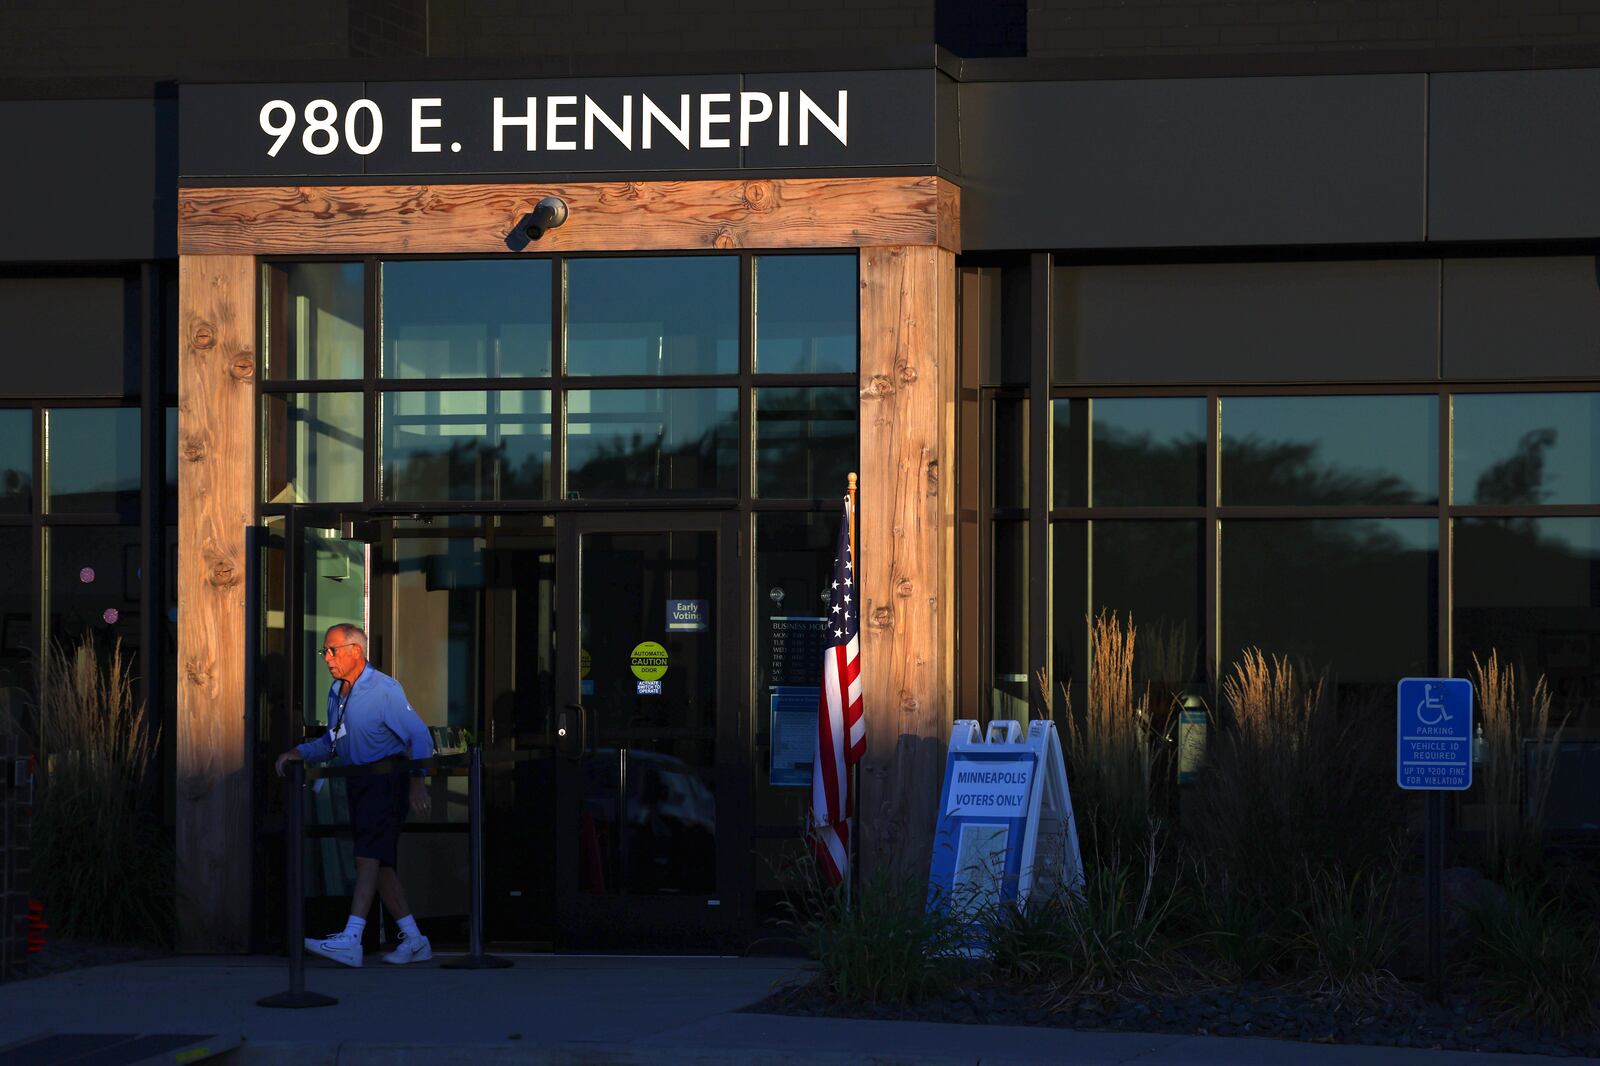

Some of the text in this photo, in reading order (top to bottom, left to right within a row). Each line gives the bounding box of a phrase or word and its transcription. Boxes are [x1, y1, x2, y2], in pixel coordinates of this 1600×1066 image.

[259, 89, 848, 158] 980 E. HENNEPIN
[677, 603, 698, 613] Early
[772, 622, 806, 630] BUSINESS
[631, 658, 668, 666] CAUTION
[1416, 727, 1454, 735] PARKING
[1411, 742, 1446, 750] VEHICLE
[1413, 751, 1456, 760] REQUIRED
[1404, 767, 1414, 775] UP
[1416, 767, 1425, 775] TO
[1449, 767, 1465, 776] FINE
[957, 772, 1027, 784] MINNEAPOLIS
[1425, 777, 1463, 785] VIOLATION
[956, 794, 1024, 806] VOTERS ONLY
